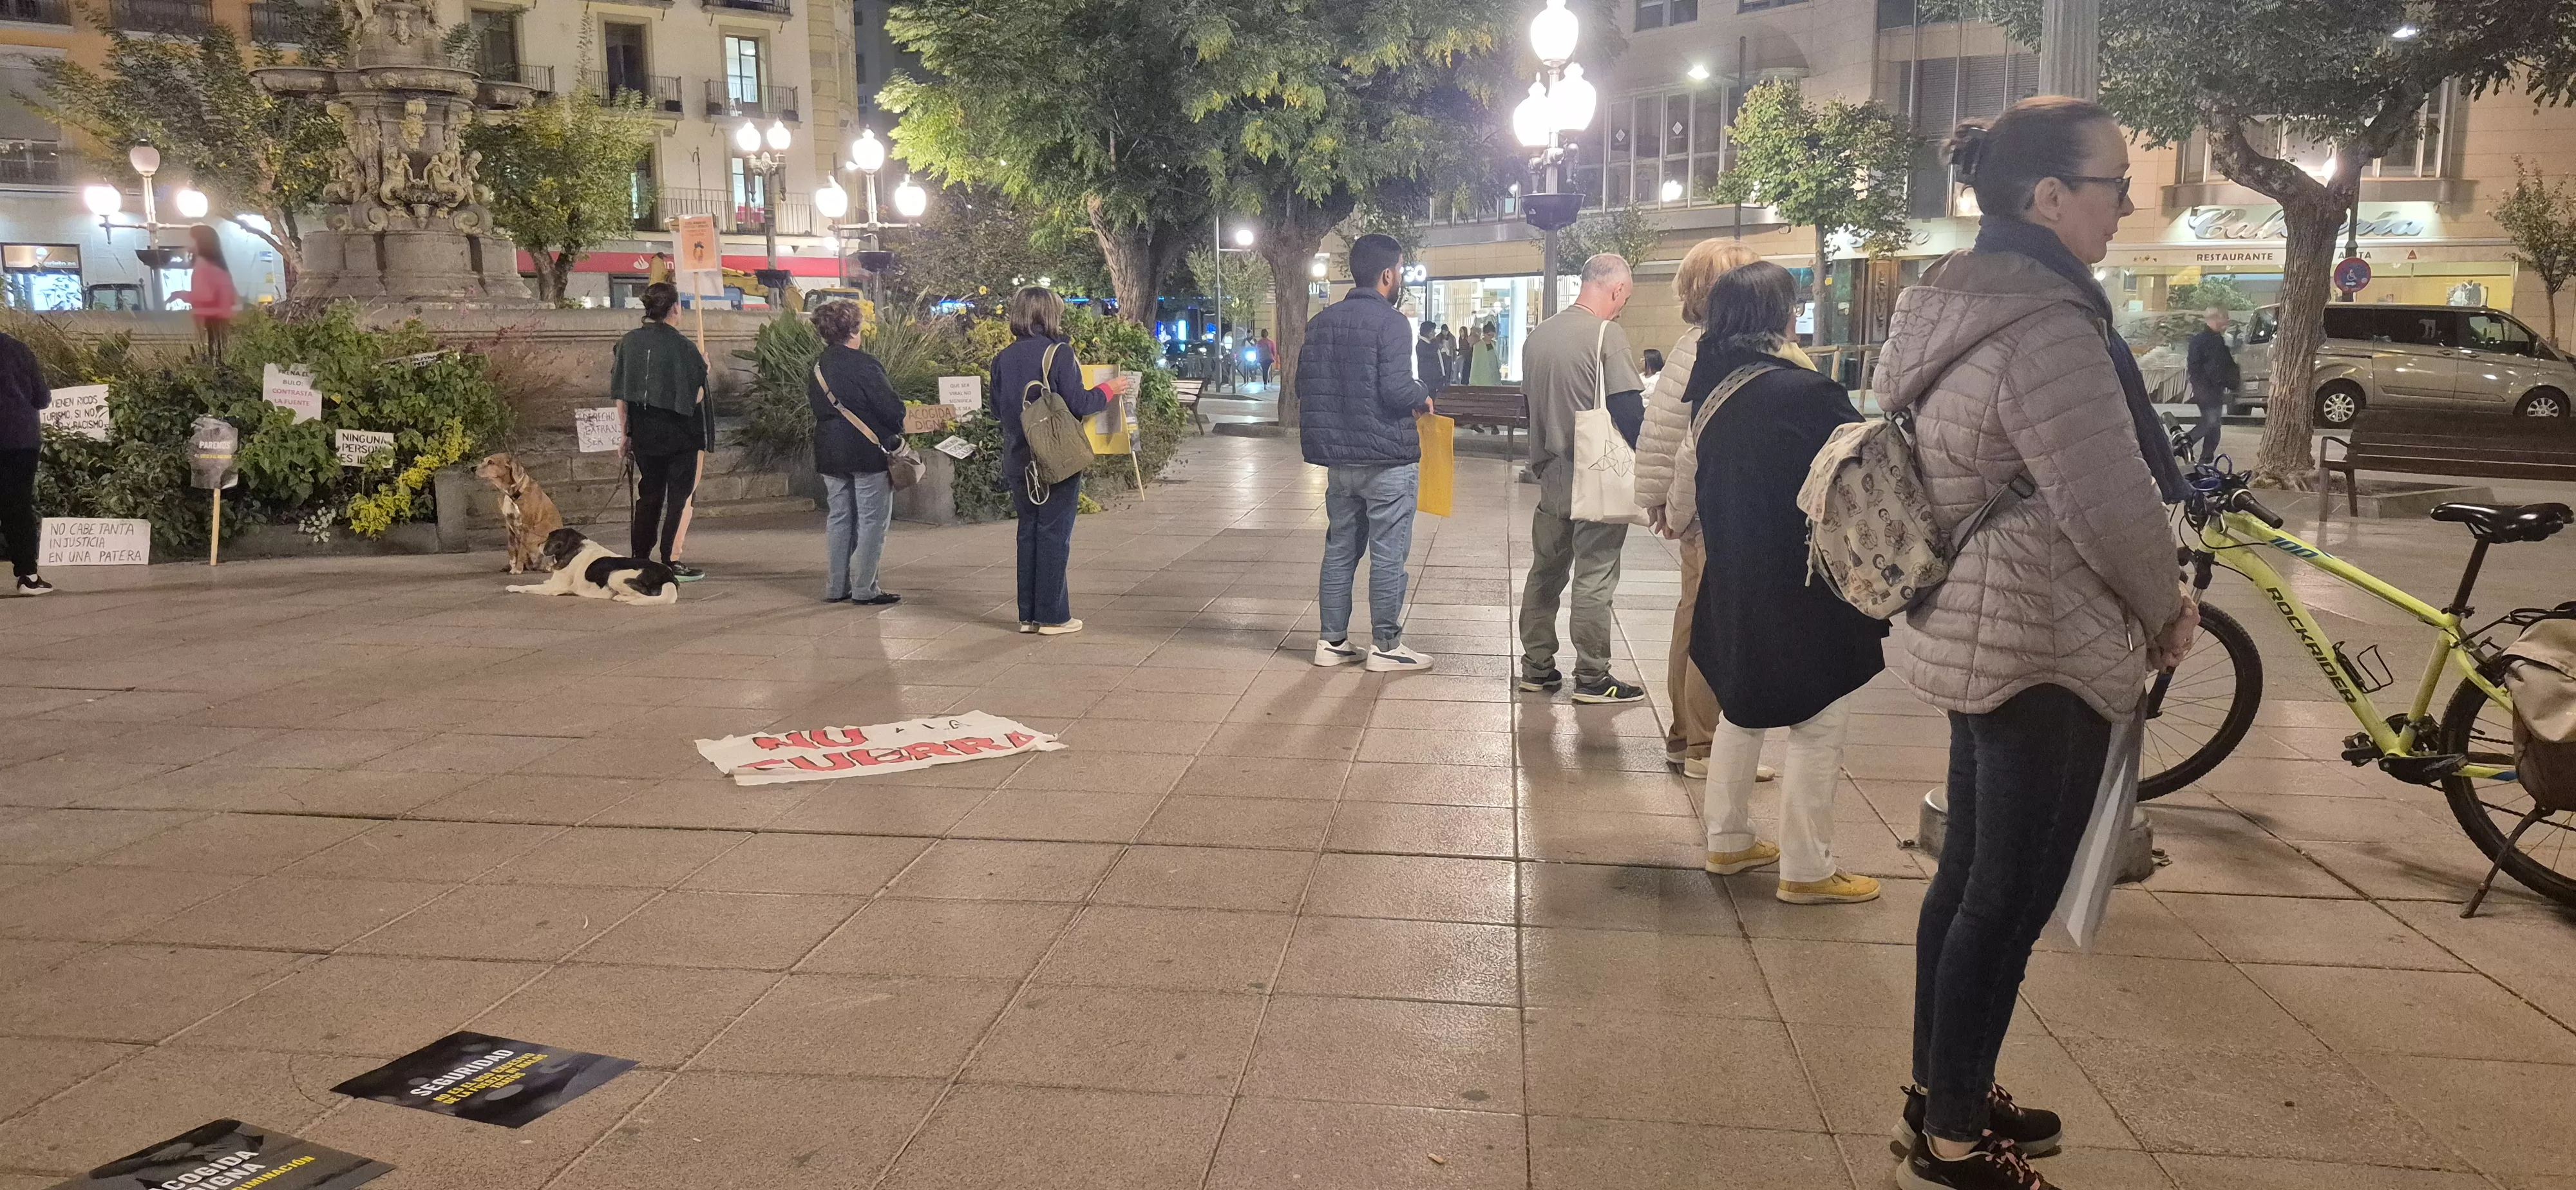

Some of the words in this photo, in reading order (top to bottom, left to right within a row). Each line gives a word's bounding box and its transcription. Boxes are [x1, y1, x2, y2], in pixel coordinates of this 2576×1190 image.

[2196, 252, 2273, 261] RESTAURANTE
[272, 388, 313, 397] CONTRASTA
[77, 395, 98, 406] RICOS
[75, 410, 81, 419] SI
[583, 411, 615, 423] DERECHO
[909, 406, 952, 420] ACOGIDA
[199, 440, 231, 449] PAREMOS
[342, 433, 386, 444] NINGUNA
[51, 523, 66, 535] NO
[70, 523, 96, 535] CABE
[99, 523, 134, 535] TANTA
[50, 536, 105, 549] INJUSTICIA
[2268, 535, 2318, 558] 100
[48, 552, 63, 563] EN
[69, 551, 91, 562] UNA
[99, 550, 142, 562] PATERA
[2266, 587, 2357, 703] ROCKRIDER
[516, 1053, 548, 1068] MALOS
[410, 1049, 515, 1097] SEGURIDAD
[433, 1093, 450, 1102] NO
[472, 1072, 495, 1082] USO
[491, 1052, 536, 1073] EXCESIVO
[489, 1072, 526, 1088] TRATOS
[147, 1151, 260, 1190] COGIDA
